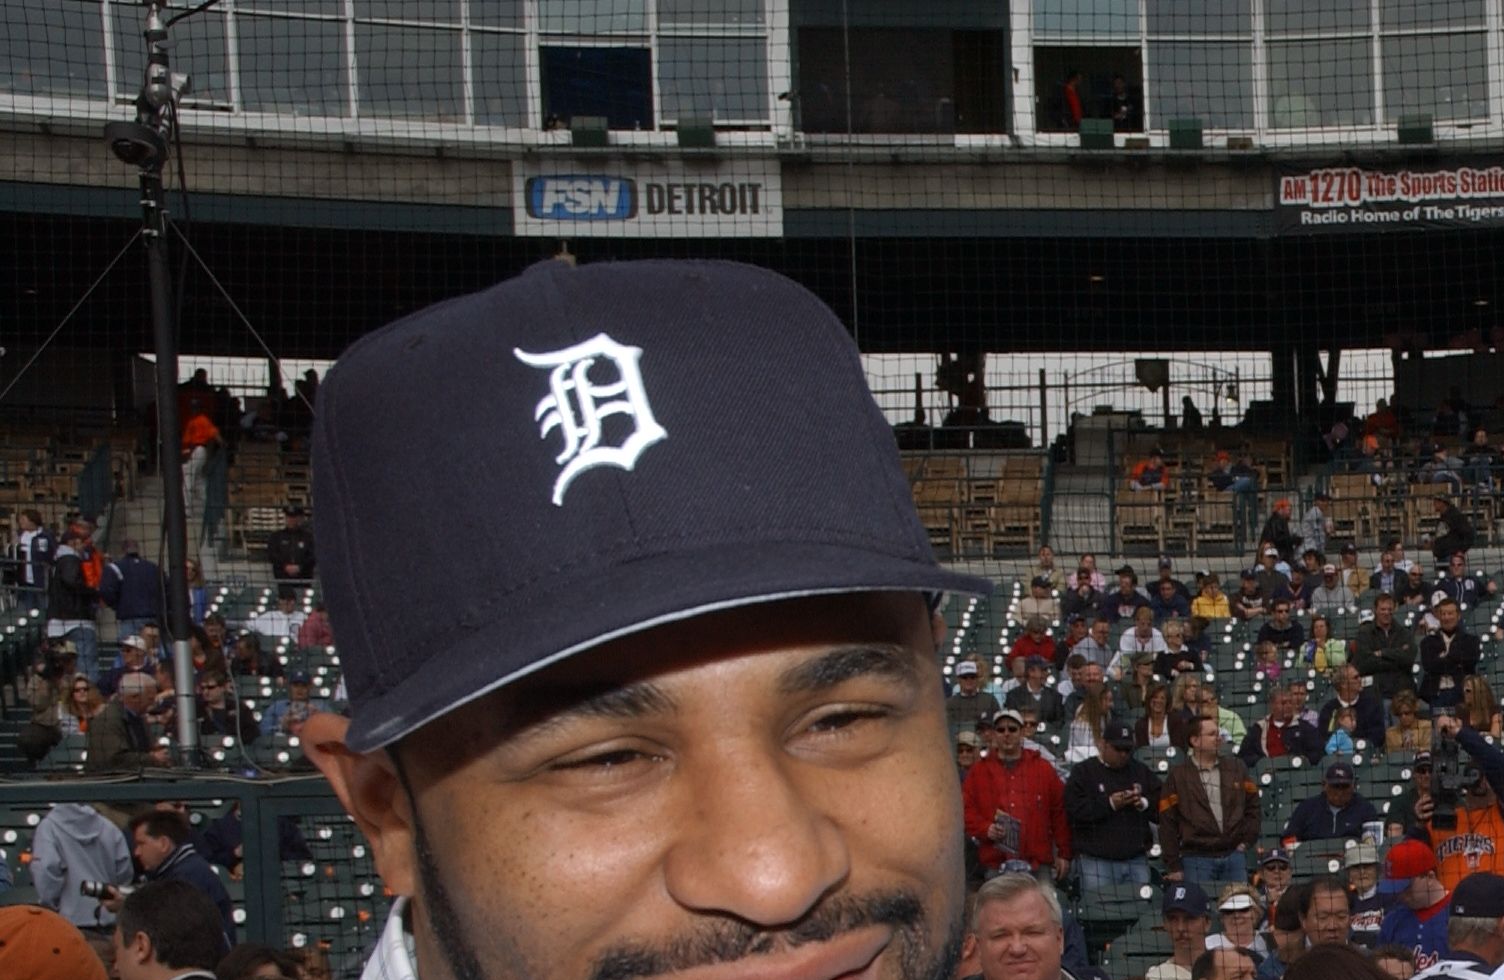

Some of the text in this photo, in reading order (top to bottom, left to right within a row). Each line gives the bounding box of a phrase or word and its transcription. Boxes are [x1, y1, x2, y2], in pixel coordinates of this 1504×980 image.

[542, 179, 762, 215] FSN DETROIT
[1283, 179, 1306, 200] AM
[1309, 170, 1361, 203] 1270
[1366, 174, 1396, 197] The
[1400, 171, 1457, 198] Sports
[1301, 210, 1348, 225] Radio
[1351, 208, 1399, 223] Home
[1403, 206, 1420, 221] of
[1422, 206, 1453, 220] The
